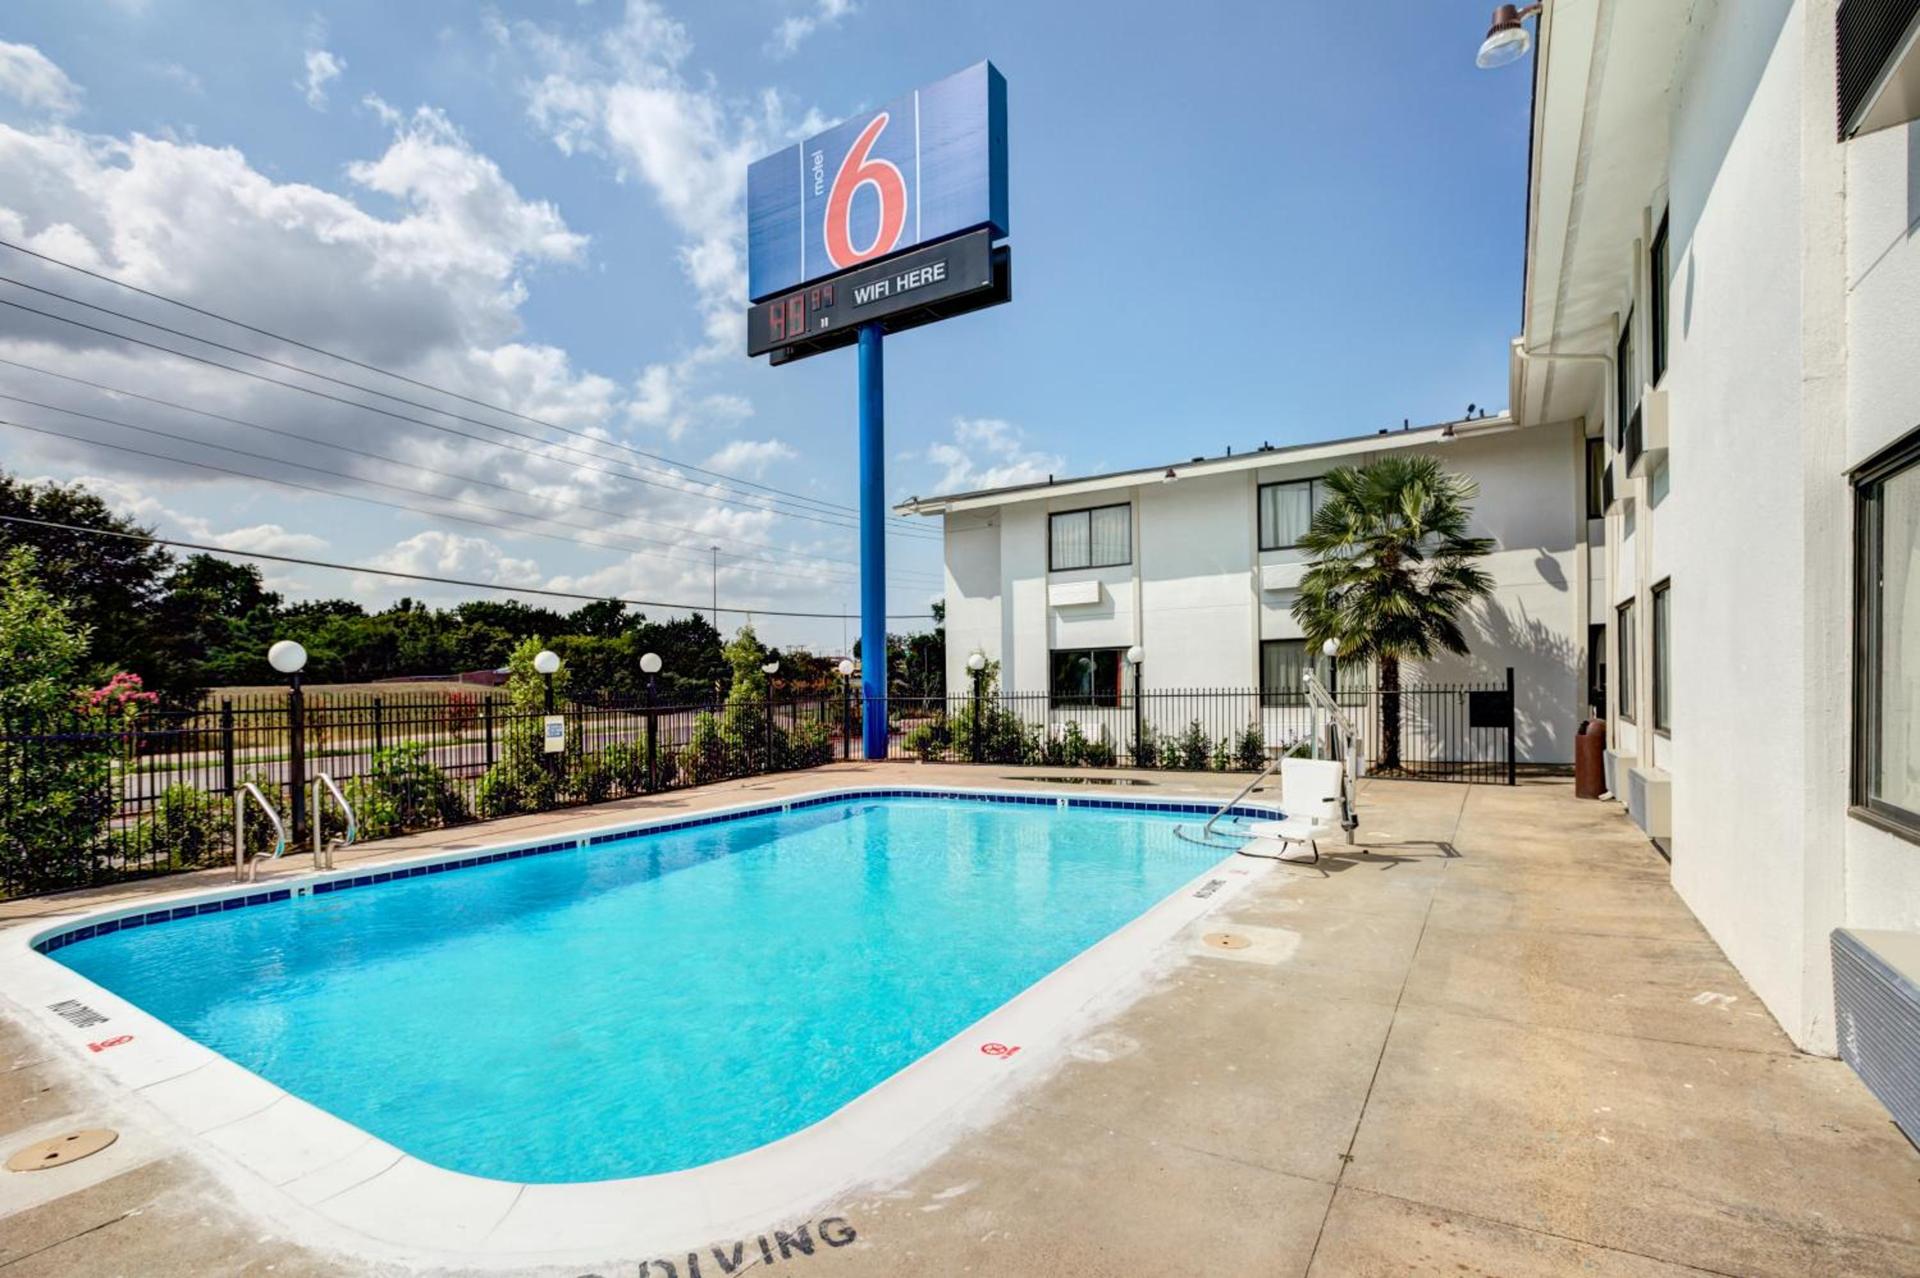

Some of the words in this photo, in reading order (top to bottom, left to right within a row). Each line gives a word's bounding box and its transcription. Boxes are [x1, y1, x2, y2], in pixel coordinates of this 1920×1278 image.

[810, 150, 824, 196] motel
[823, 111, 907, 270] 6
[854, 280, 889, 304] WIFI
[896, 262, 946, 292] HERE
